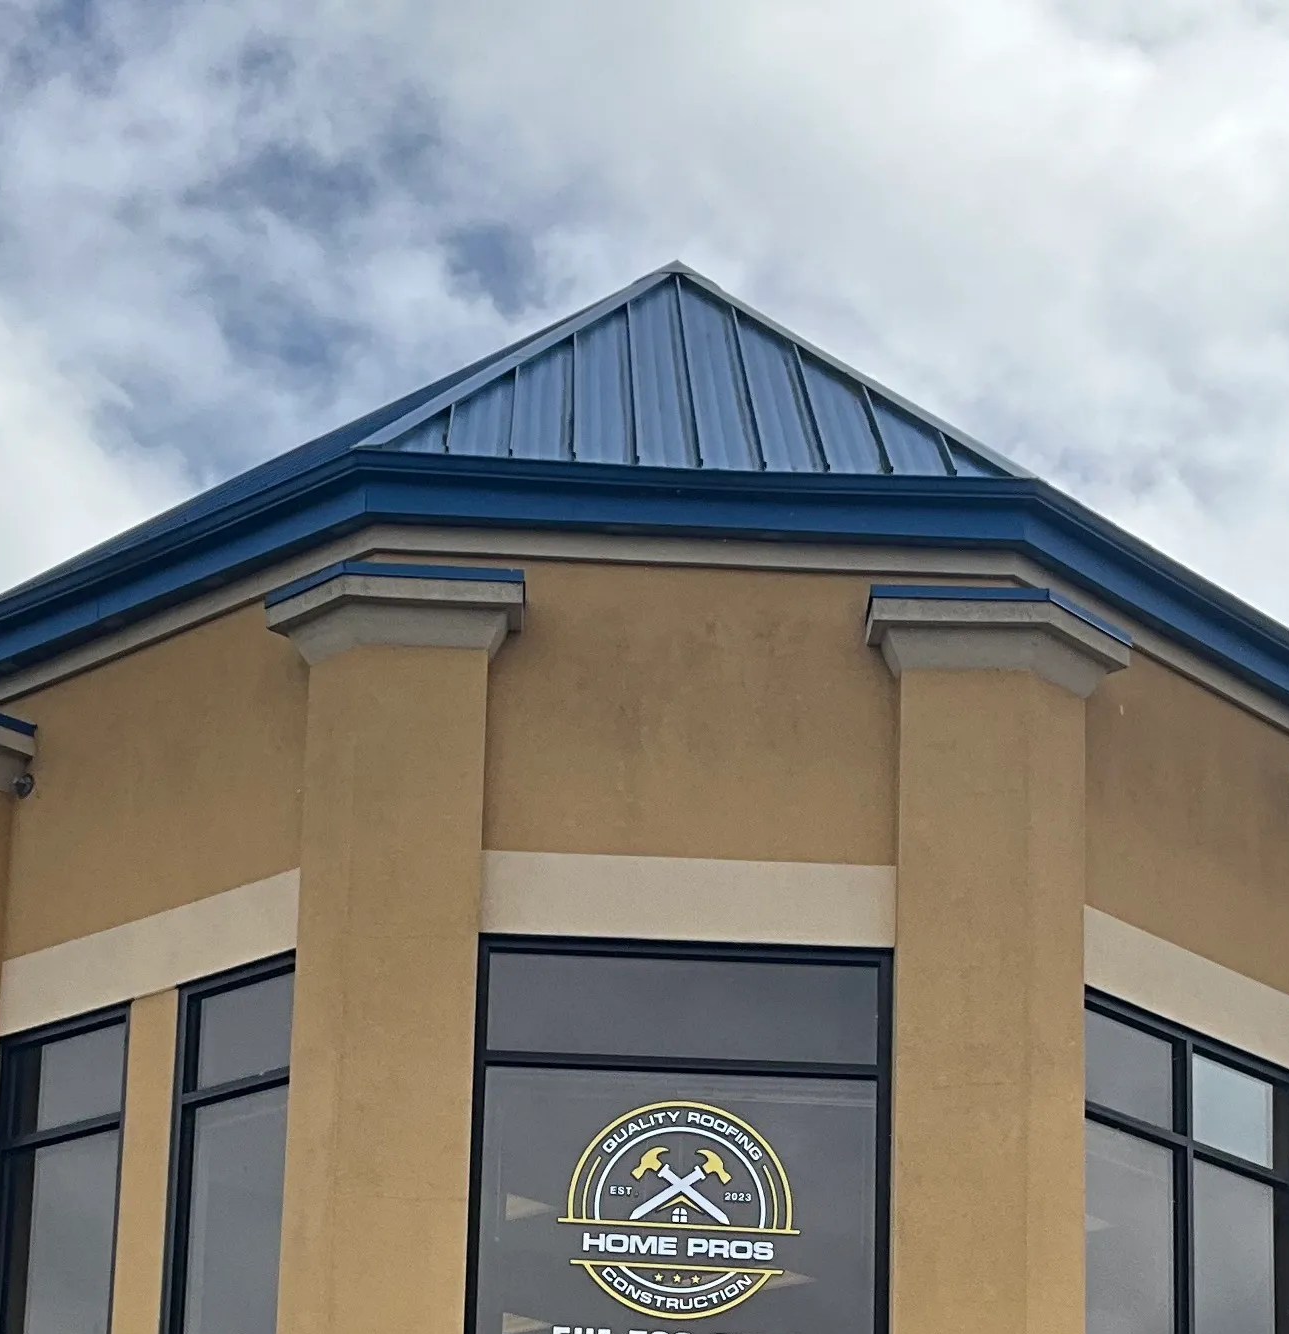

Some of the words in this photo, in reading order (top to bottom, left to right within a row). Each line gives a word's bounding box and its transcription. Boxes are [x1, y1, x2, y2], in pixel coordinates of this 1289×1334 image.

[602, 1110, 680, 1154] QUALITY
[686, 1111, 763, 1161] ROOFING
[723, 1190, 753, 1203] 2023
[581, 1232, 678, 1257] HOME
[686, 1237, 774, 1261] PROS
[600, 1266, 754, 1311] CONSTRUCTION
